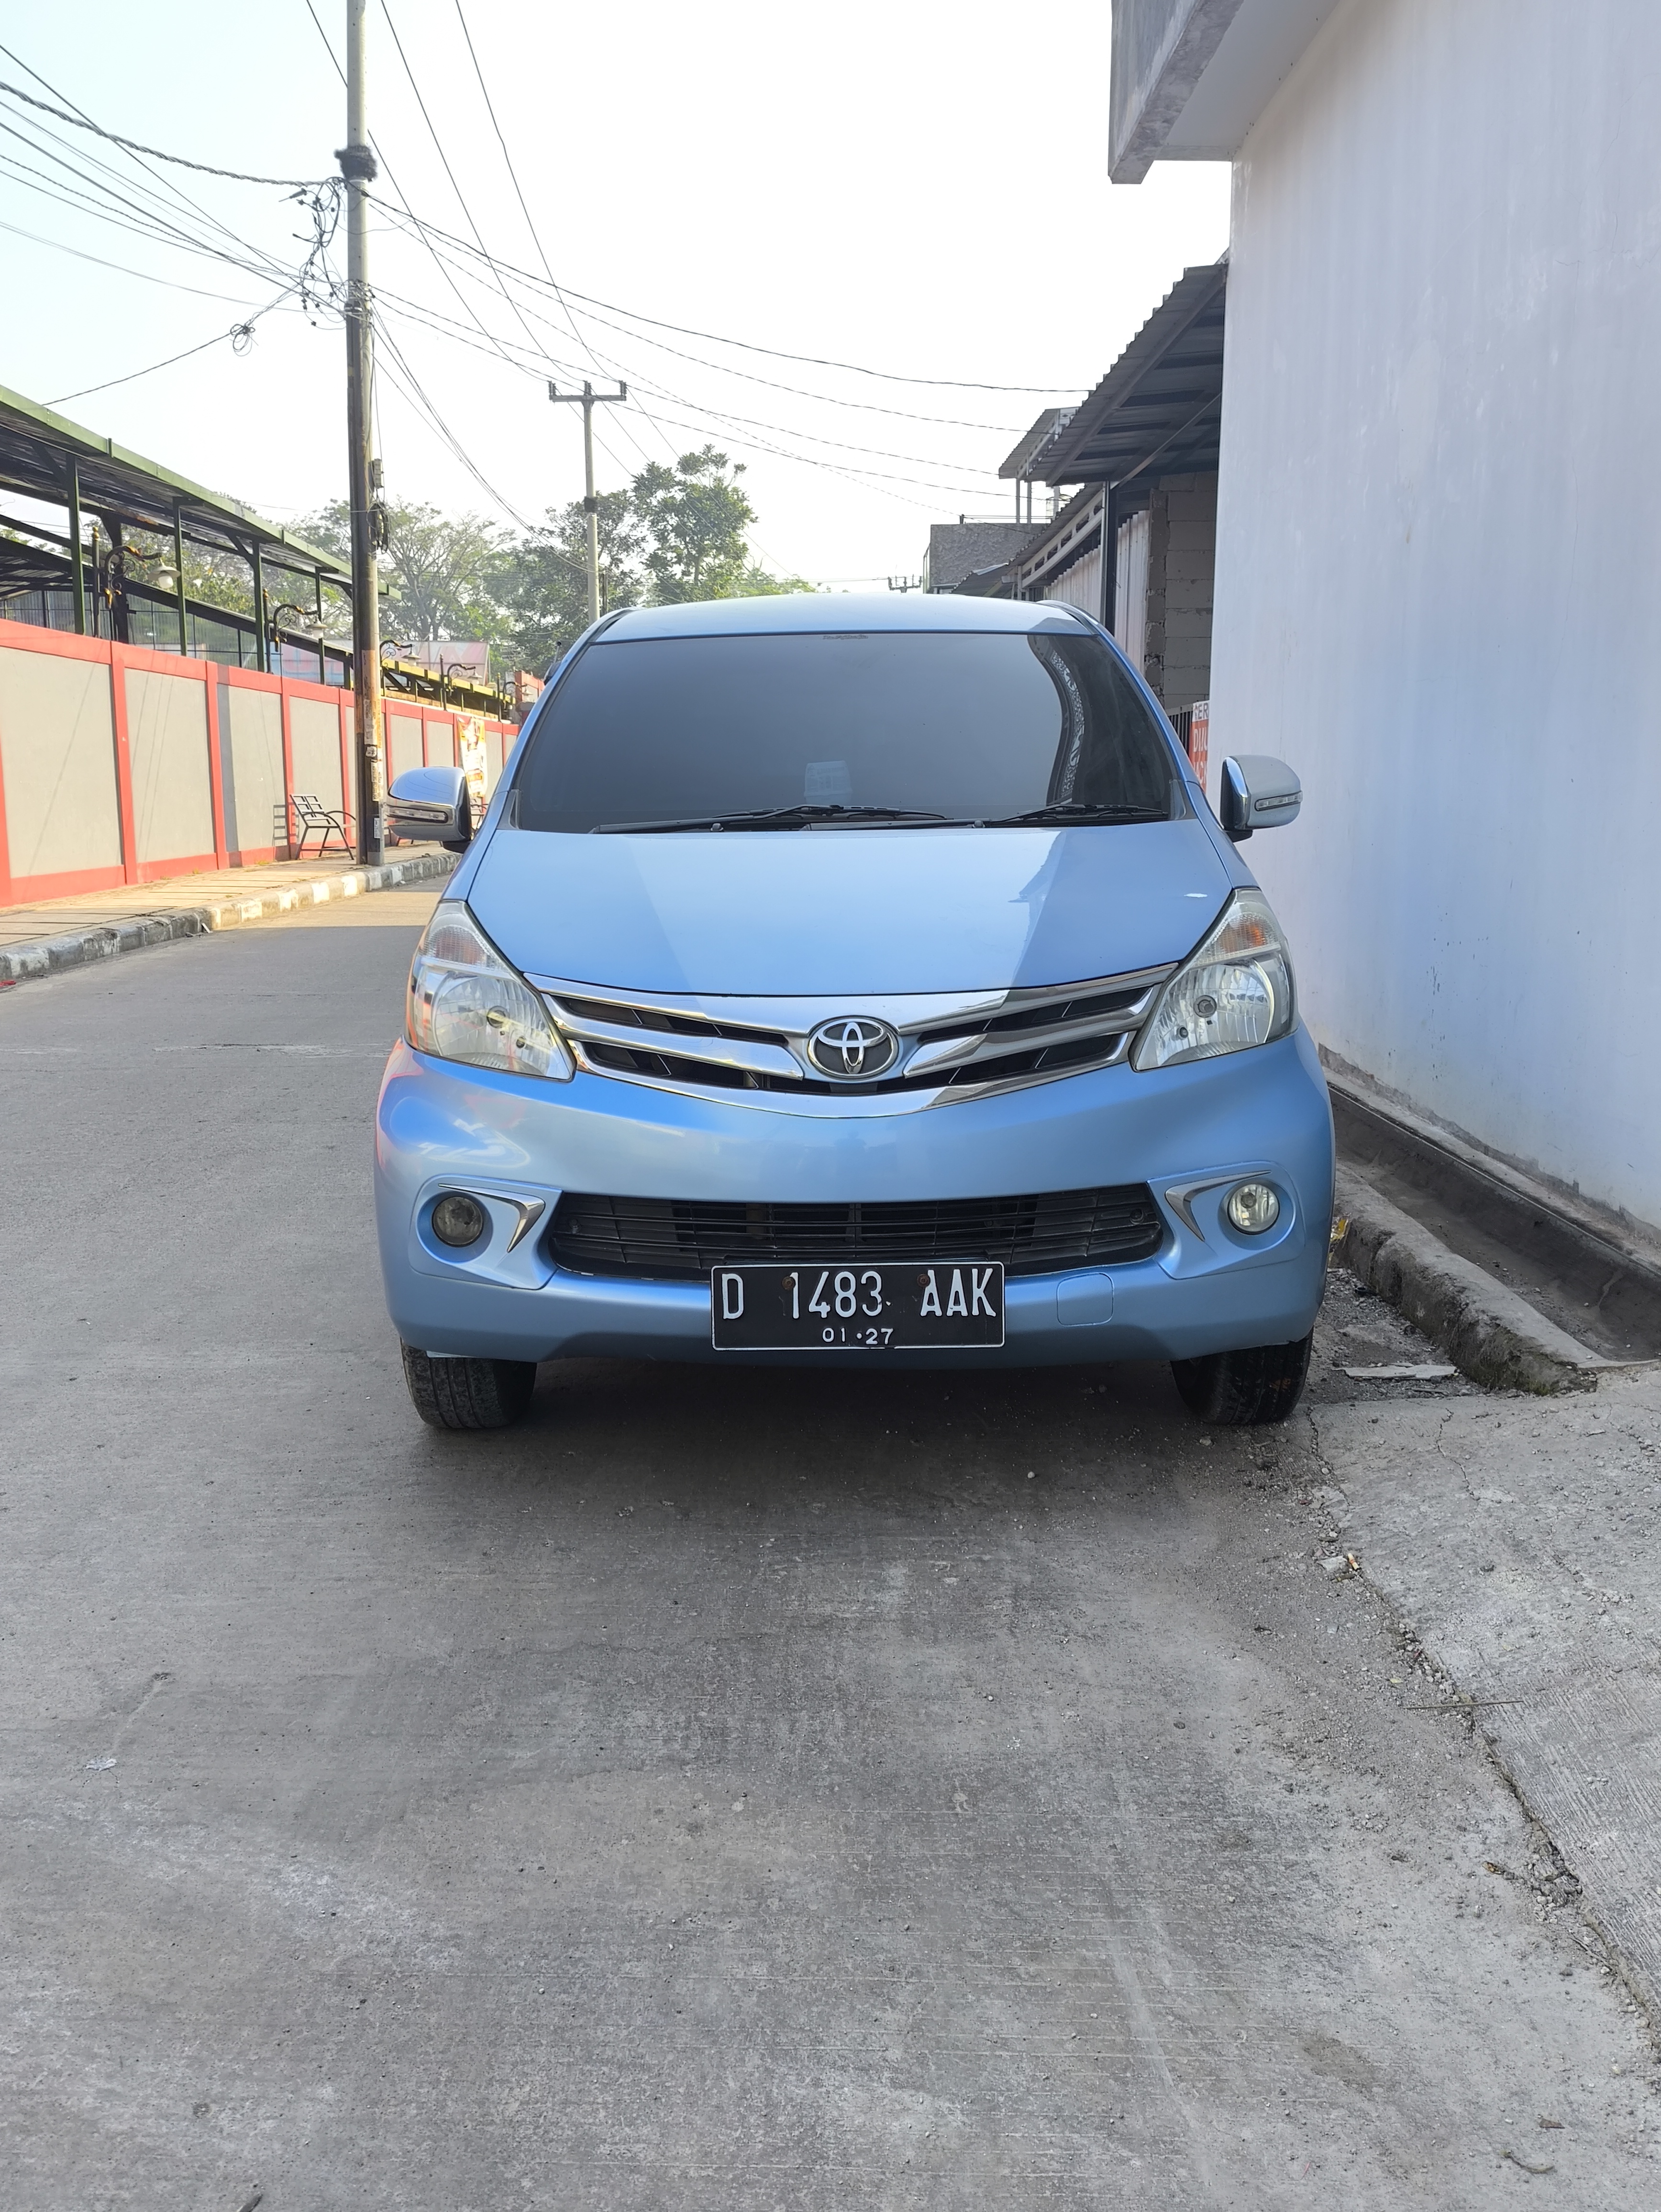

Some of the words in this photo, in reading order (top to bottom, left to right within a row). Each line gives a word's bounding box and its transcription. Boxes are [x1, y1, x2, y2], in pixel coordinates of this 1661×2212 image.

[721, 1273, 744, 1319] D
[789, 1271, 882, 1319] 1483
[919, 1268, 996, 1317] AAK
